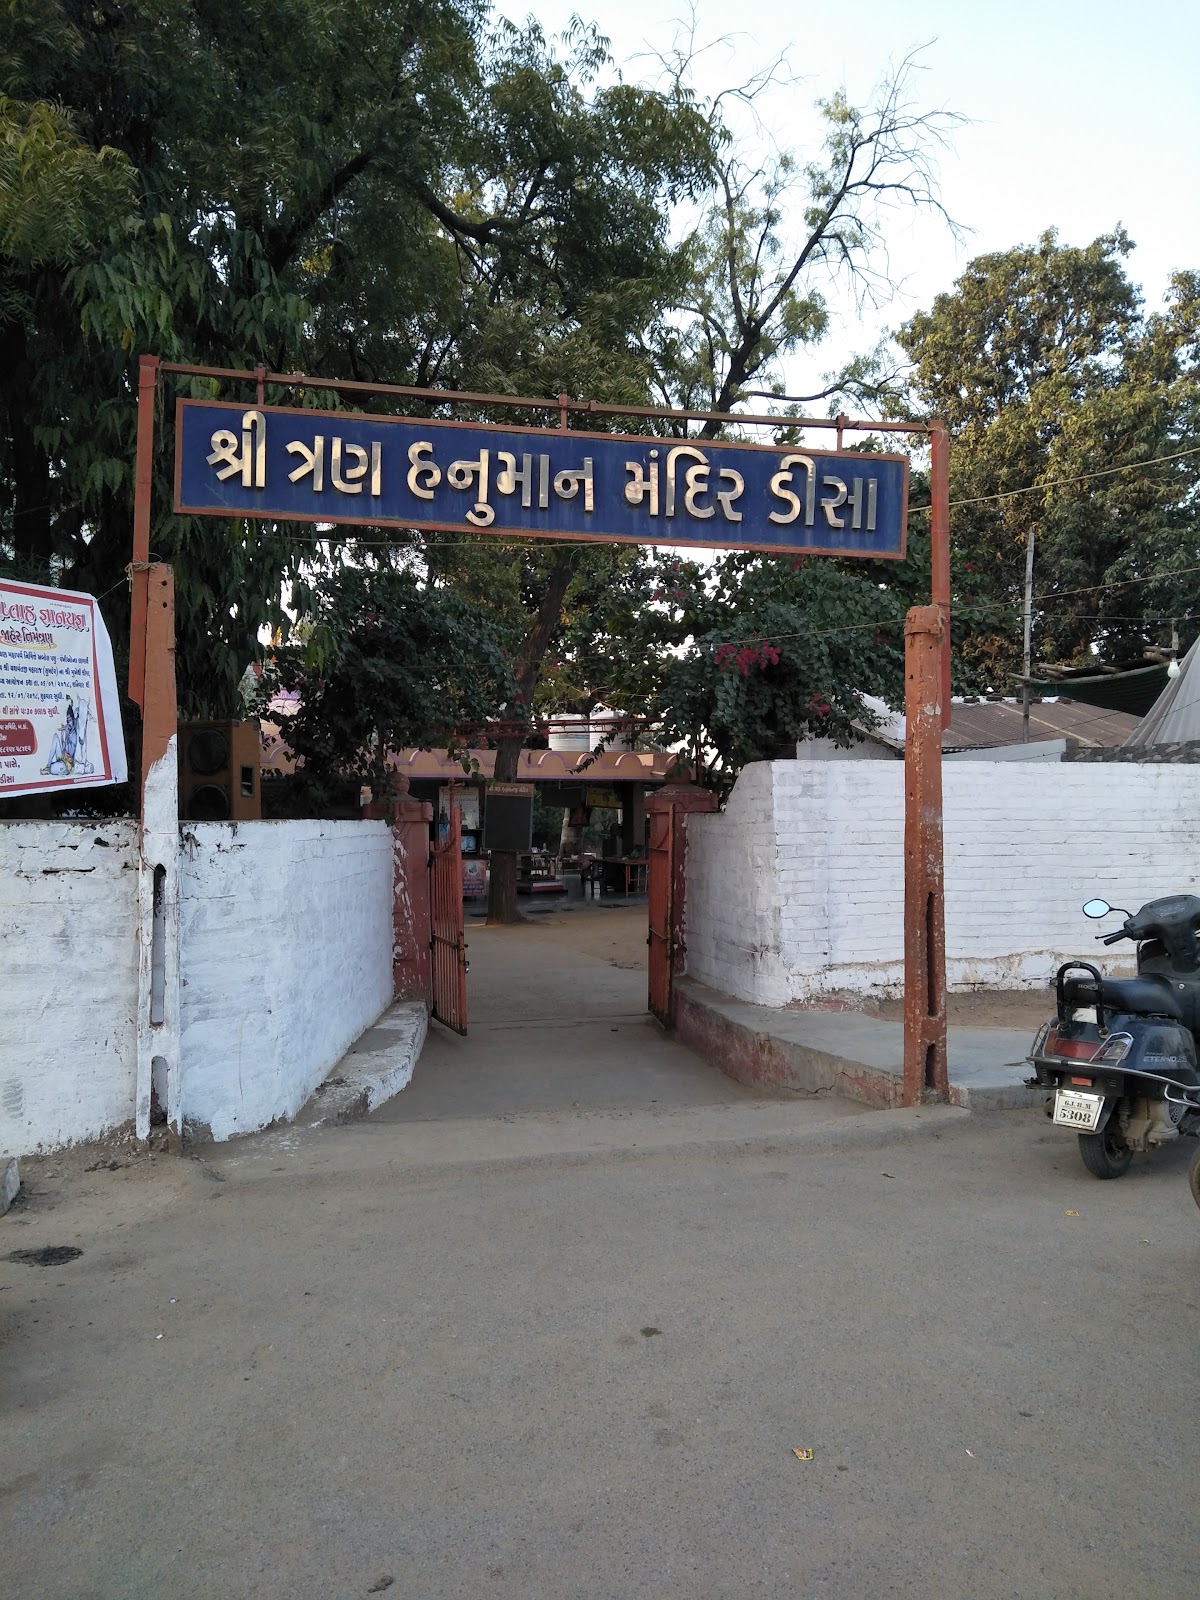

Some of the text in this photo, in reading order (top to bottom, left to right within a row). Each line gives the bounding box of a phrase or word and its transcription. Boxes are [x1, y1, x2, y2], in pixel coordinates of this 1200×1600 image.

[206, 410, 878, 531] શ્રી ત્રણ હનુમાન મંદિર ડીસા
[0, 601, 36, 625] પ્તાહ
[1059, 1108, 1092, 1123] 5308
